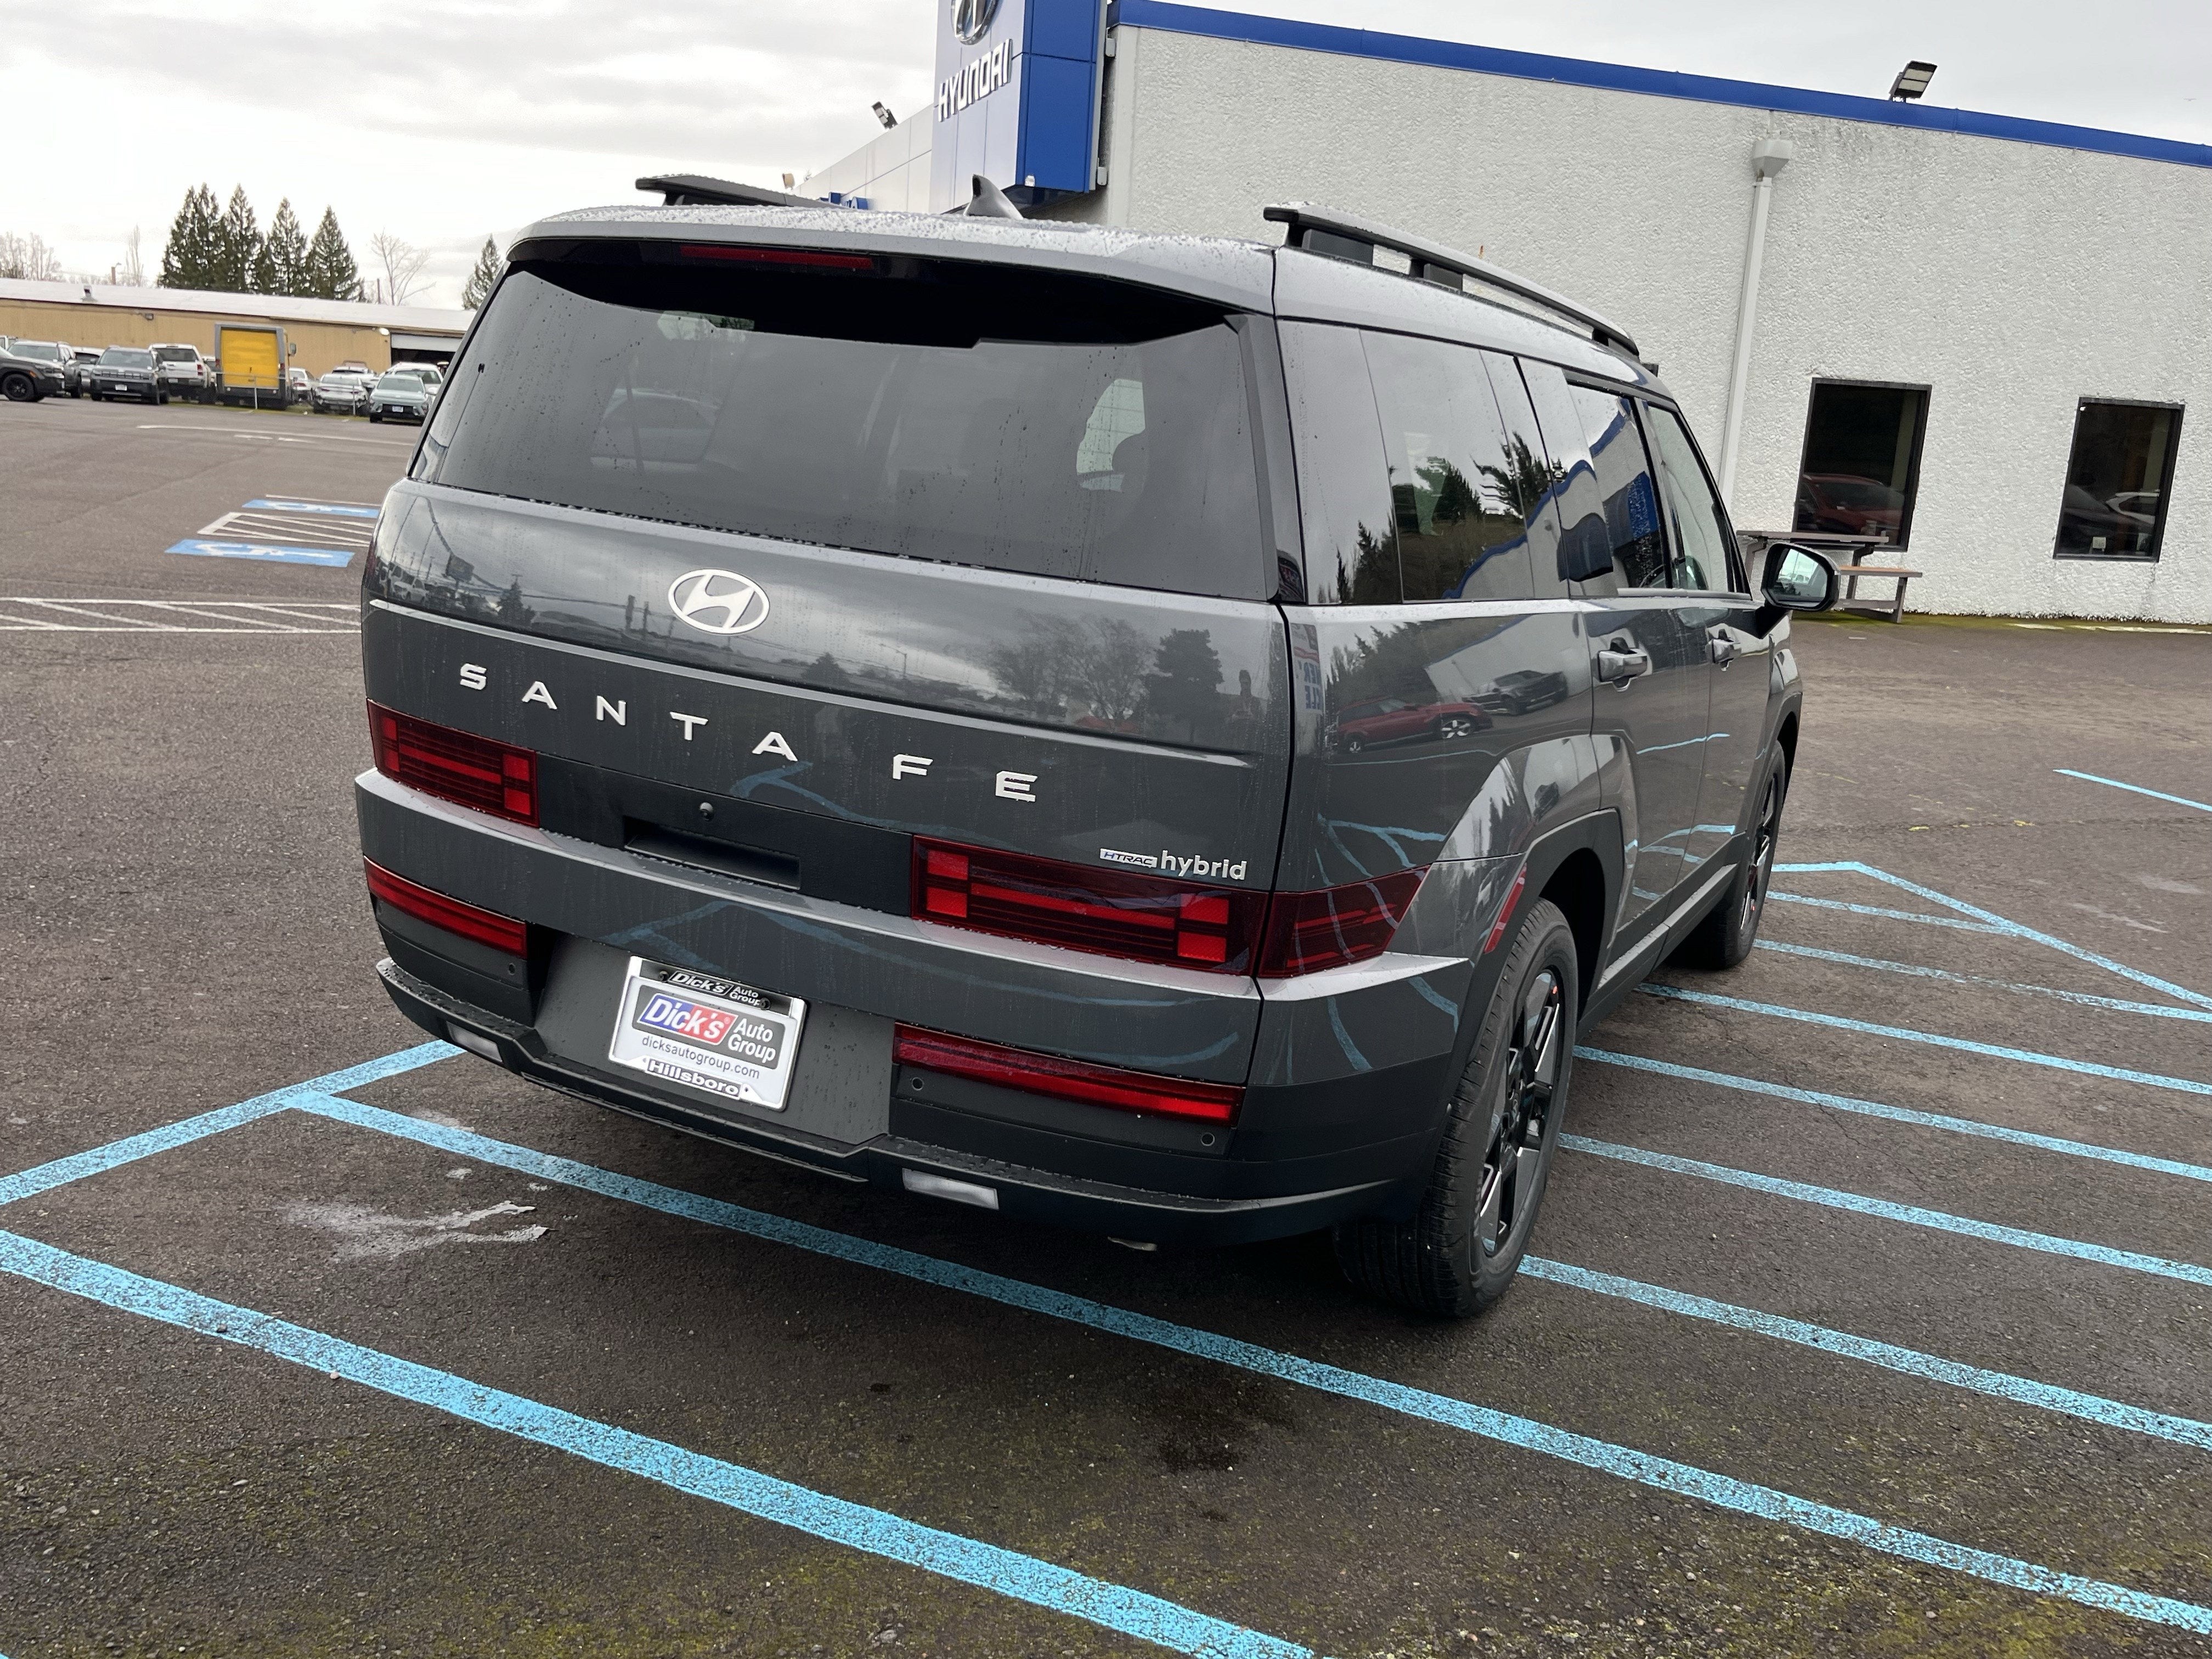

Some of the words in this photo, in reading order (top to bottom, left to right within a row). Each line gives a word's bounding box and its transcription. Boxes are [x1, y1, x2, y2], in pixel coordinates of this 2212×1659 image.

[938, 38, 1012, 122] HYUNDAI
[460, 663, 798, 761] SANTA
[893, 754, 1037, 802] FE
[1104, 851, 1154, 865] HTRAC
[1160, 850, 1247, 880] hybrid
[672, 973, 726, 994] Dick's
[729, 991, 761, 1006] Group
[733, 986, 759, 998] Auto
[644, 997, 725, 1041] Dick's
[733, 1019, 774, 1042] Auto
[642, 1035, 760, 1079] dicksautogroup.com
[728, 1034, 776, 1064] Group
[647, 1059, 740, 1096] Hillsboro
